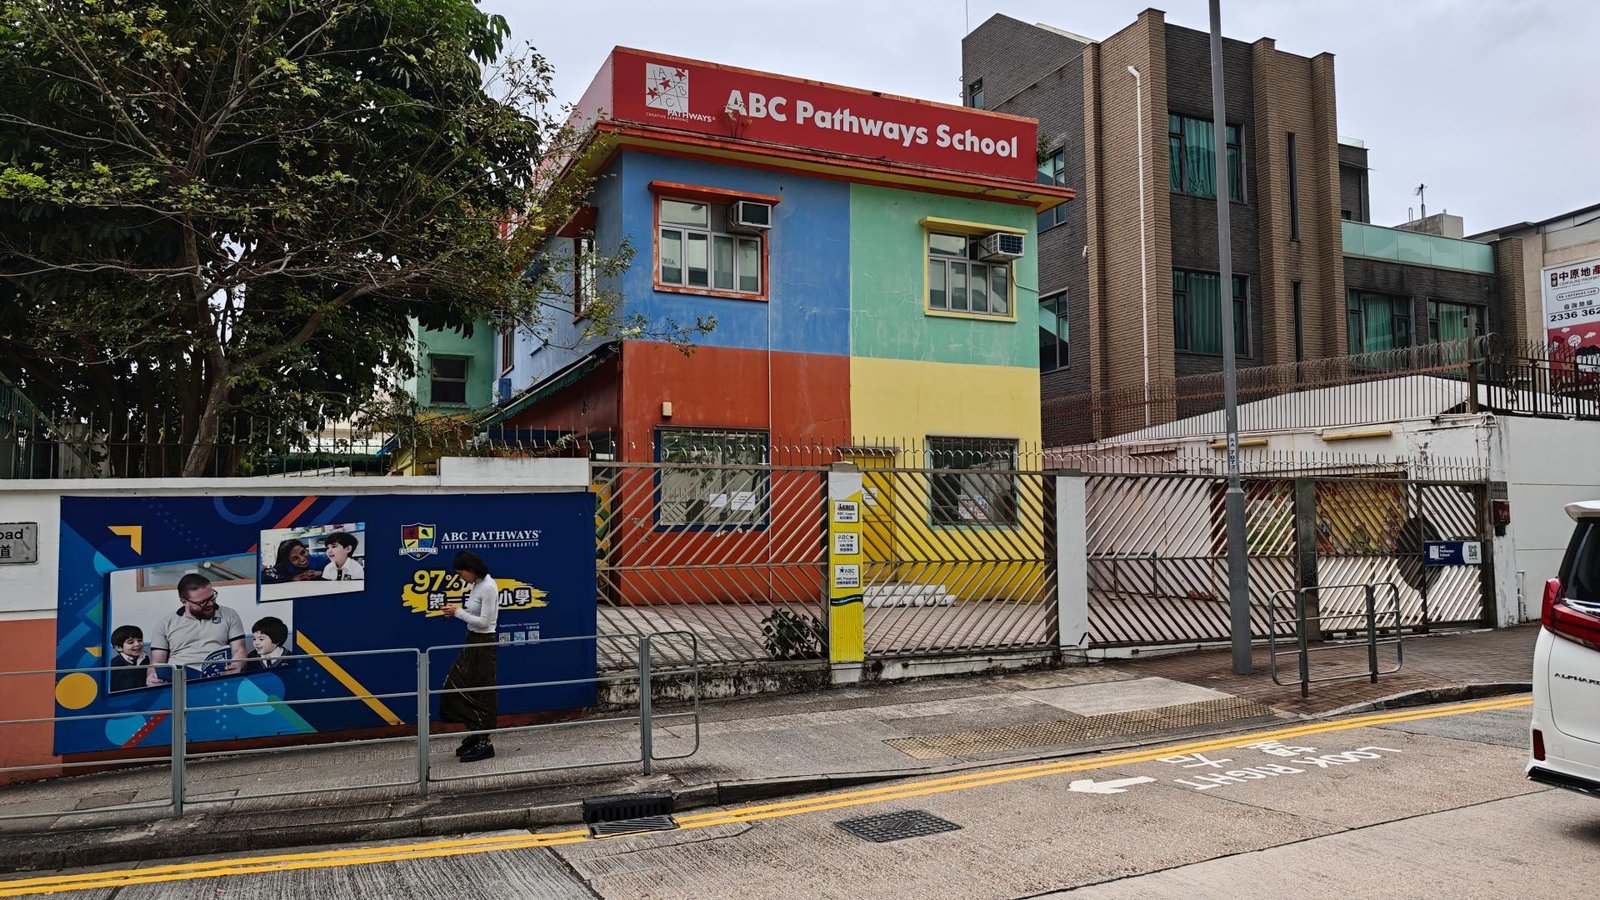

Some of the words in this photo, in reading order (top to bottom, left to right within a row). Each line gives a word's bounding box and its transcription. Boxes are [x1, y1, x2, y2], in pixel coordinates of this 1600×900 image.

[724, 89, 788, 122] ABC
[796, 99, 929, 147] Pathways
[936, 124, 1018, 158] School
[1550, 311, 1578, 322] 2336
[441, 531, 468, 542] ABC
[413, 569, 460, 592] 97%
[1290, 746, 1402, 768] LOOK
[1173, 763, 1306, 790] RIGHT
